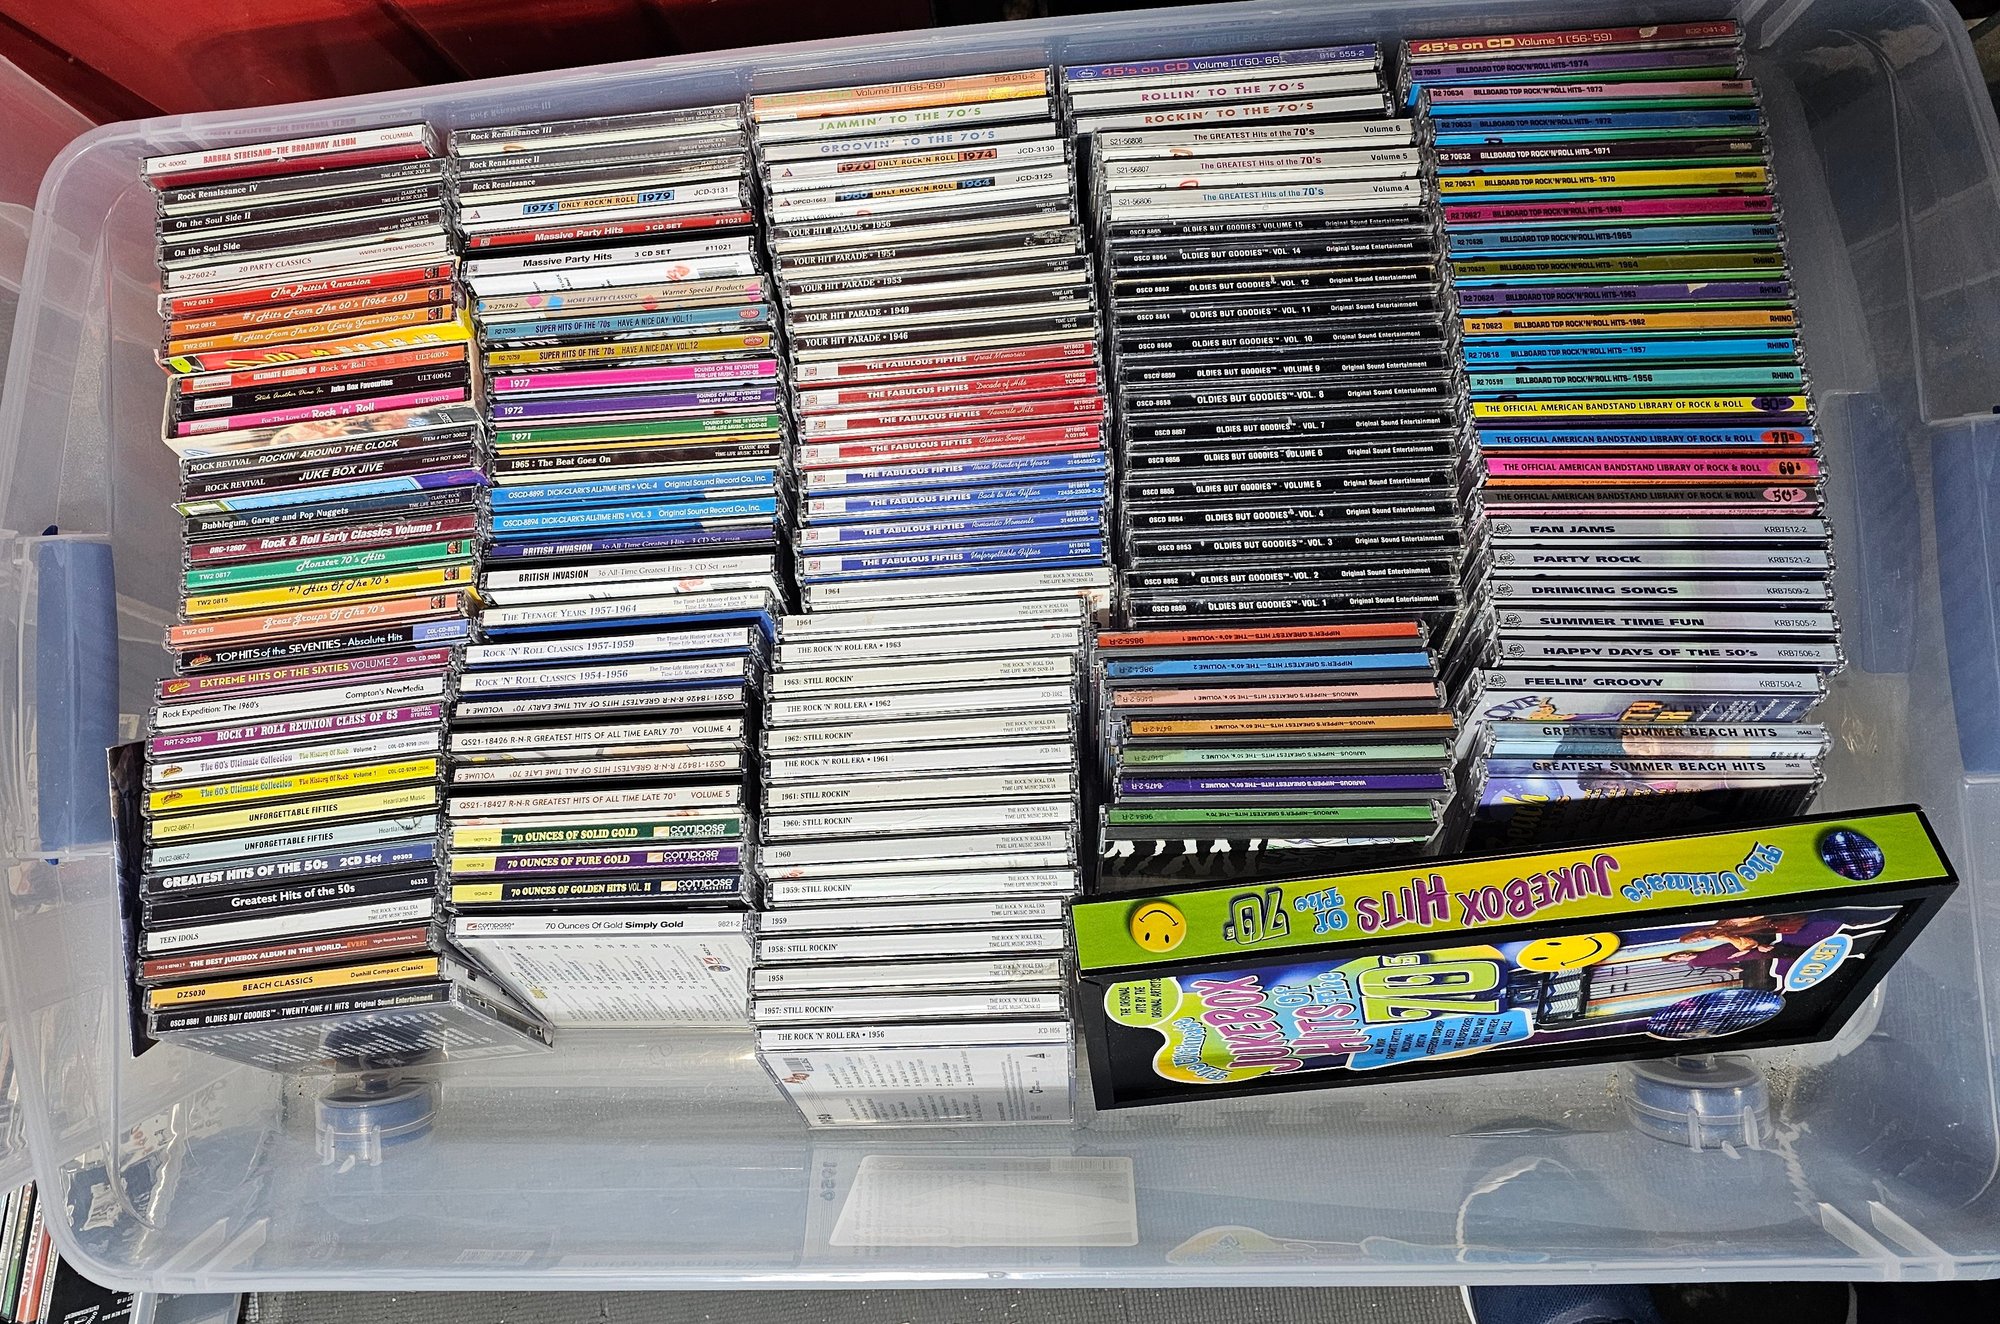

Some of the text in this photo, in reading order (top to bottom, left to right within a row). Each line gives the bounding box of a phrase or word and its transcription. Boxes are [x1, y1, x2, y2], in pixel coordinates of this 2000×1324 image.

[1418, 35, 1562, 53] 45's on CD Volume 1
[819, 108, 980, 130] JAMMIN' TO THE 70'S
[378, 131, 415, 141] COLUMBIA
[1209, 131, 1249, 139] GREATEST
[1293, 127, 1314, 135] 70's
[177, 184, 258, 200] Rock Renaissance IV
[524, 203, 554, 212] 1975
[641, 191, 674, 201] 1979
[533, 226, 624, 242] Massive Party Hits
[249, 262, 272, 271] PARTY
[275, 258, 311, 267] CLASSICS
[179, 270, 216, 280] 9-27602-2
[805, 332, 908, 346] YOUR HIT PARADE 1946
[885, 359, 931, 368] FABULOUS
[935, 356, 966, 364] FIFTIES
[1585, 402, 1636, 410] BANDSTAND
[1638, 401, 1672, 409] LIBRARY
[190, 439, 400, 470] ROCK REVIVAL ROCKIN' AROUND THE CLOCK
[298, 462, 385, 480] JUKE BOX JIVE
[1528, 525, 1616, 534] FAN JAMS
[1531, 555, 1641, 563] PARTY ROCK
[1767, 556, 1811, 564] KRB7521-2
[518, 570, 588, 581] BRITISH INVASION
[502, 604, 636, 621] THE TEENAGE YEARS 1957-1964
[1540, 617, 1707, 626] SUMMER TIME FUN
[1542, 647, 1757, 657] HAPPY DAYS OF THE 50's
[200, 664, 349, 687] EXTREME HITS OF THE SIXTIES
[1523, 677, 1662, 686] FEELIN' GROOVY
[345, 688, 384, 698] Compton's
[162, 710, 180, 718] Rock
[182, 706, 220, 716] Expedition:
[223, 703, 236, 711] The
[1530, 761, 1765, 771] GREATEST SUMMER BEACH HITS
[249, 804, 337, 821] UNFORGETTABLE FIFTIES
[162, 854, 382, 888] GREATEST HITS OF THE 50s 2CD Set
[1621, 841, 1784, 902] The Ultimate
[1294, 886, 1345, 912] The
[1355, 874, 1450, 933] HITS
[625, 921, 657, 929] Simply
[660, 920, 683, 928] Gold
[716, 920, 744, 928] 9821-2
[1314, 908, 1348, 934] Of
[242, 976, 312, 991] BEACH CLASSICS
[1314, 972, 1347, 1004] The
[176, 989, 205, 998] DZS030
[1274, 985, 1314, 1007] Of
[868, 1030, 884, 1038] 1956
[1292, 1004, 1370, 1055] HITS
